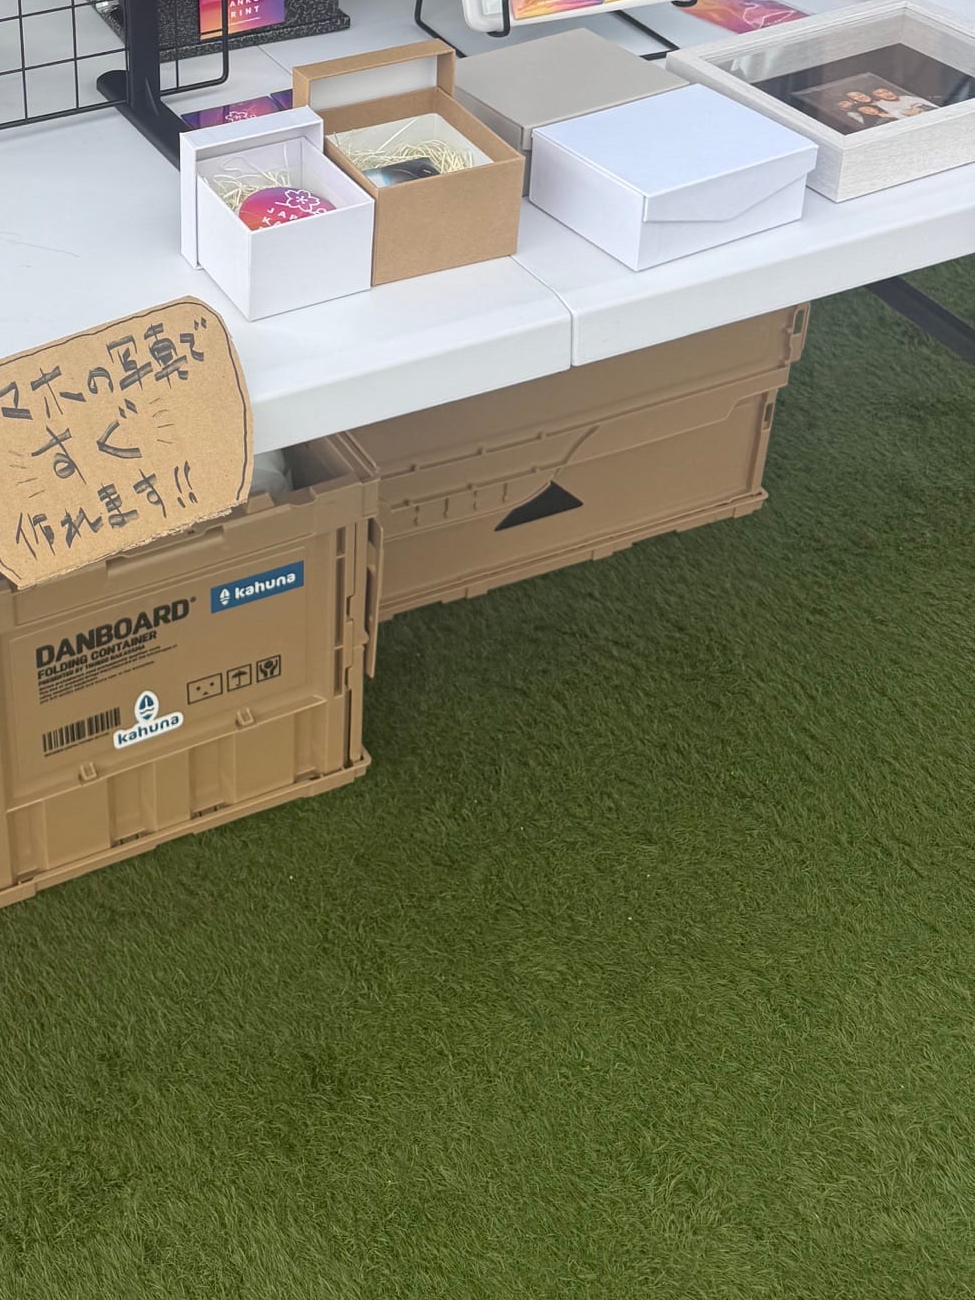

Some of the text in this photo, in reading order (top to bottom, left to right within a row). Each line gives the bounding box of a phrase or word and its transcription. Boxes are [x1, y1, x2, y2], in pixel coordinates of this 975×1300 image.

[230, 5, 260, 18] RINT
[31, 399, 142, 485] すぐ
[234, 572, 296, 600] kahuna
[36, 598, 191, 668] DANBOARD
[38, 656, 88, 679] FOLDING
[91, 630, 157, 660] CONTAINER
[117, 714, 180, 745] kahuna
